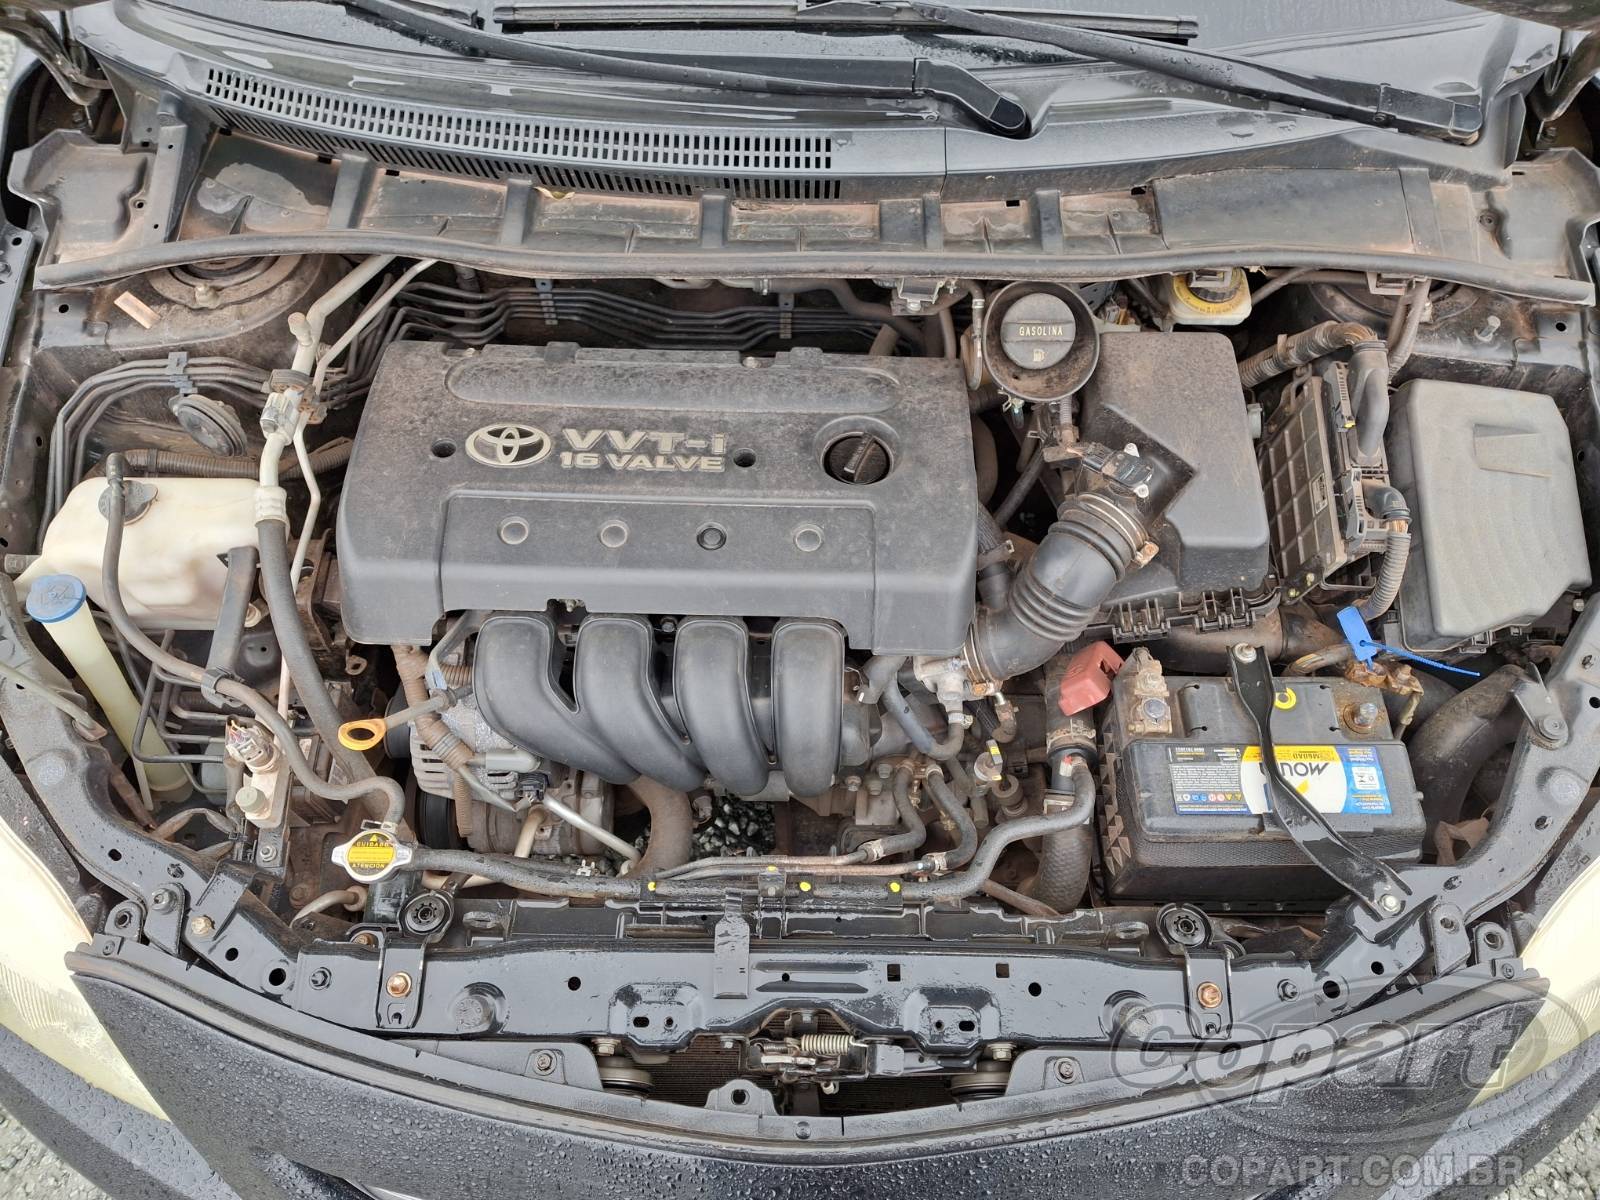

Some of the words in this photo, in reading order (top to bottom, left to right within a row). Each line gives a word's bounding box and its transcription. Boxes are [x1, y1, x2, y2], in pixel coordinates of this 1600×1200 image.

[1018, 325, 1064, 337] GASOLINA
[559, 452, 601, 469] 16
[604, 453, 725, 473] VALVE
[1258, 762, 1330, 777] MOU
